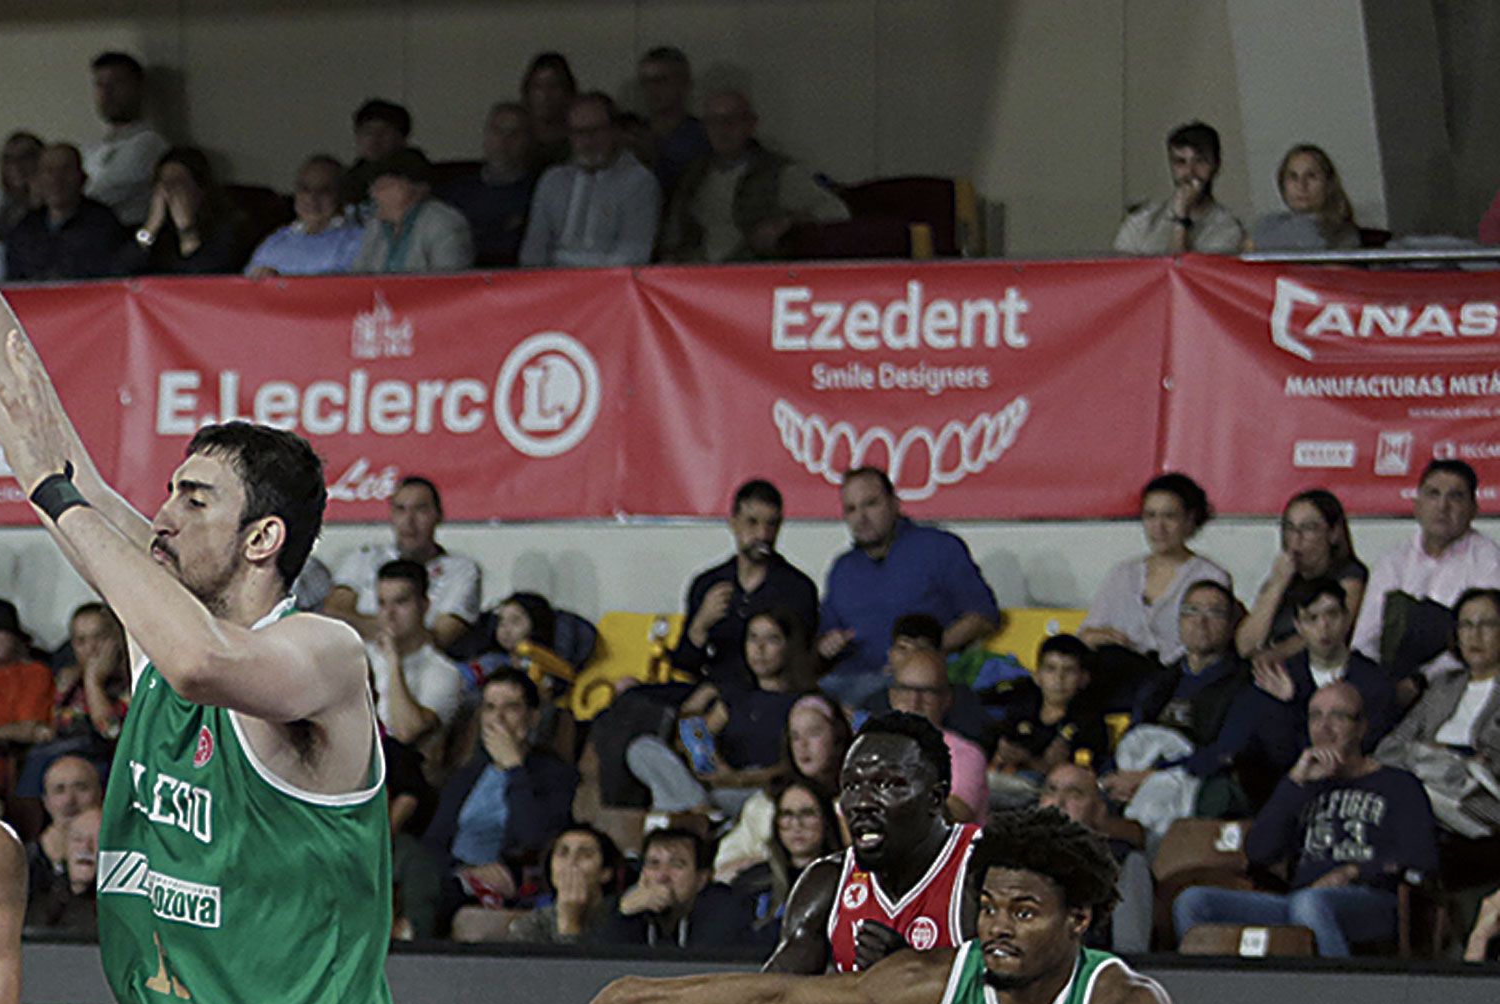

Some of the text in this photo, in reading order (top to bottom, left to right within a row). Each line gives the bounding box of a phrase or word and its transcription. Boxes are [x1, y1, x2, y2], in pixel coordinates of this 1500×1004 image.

[772, 280, 1030, 350] Ezedent
[156, 368, 489, 436] E.Leclerc
[812, 362, 990, 395] Smile Designers
[1285, 375, 1445, 396] MANUFACTURAS
